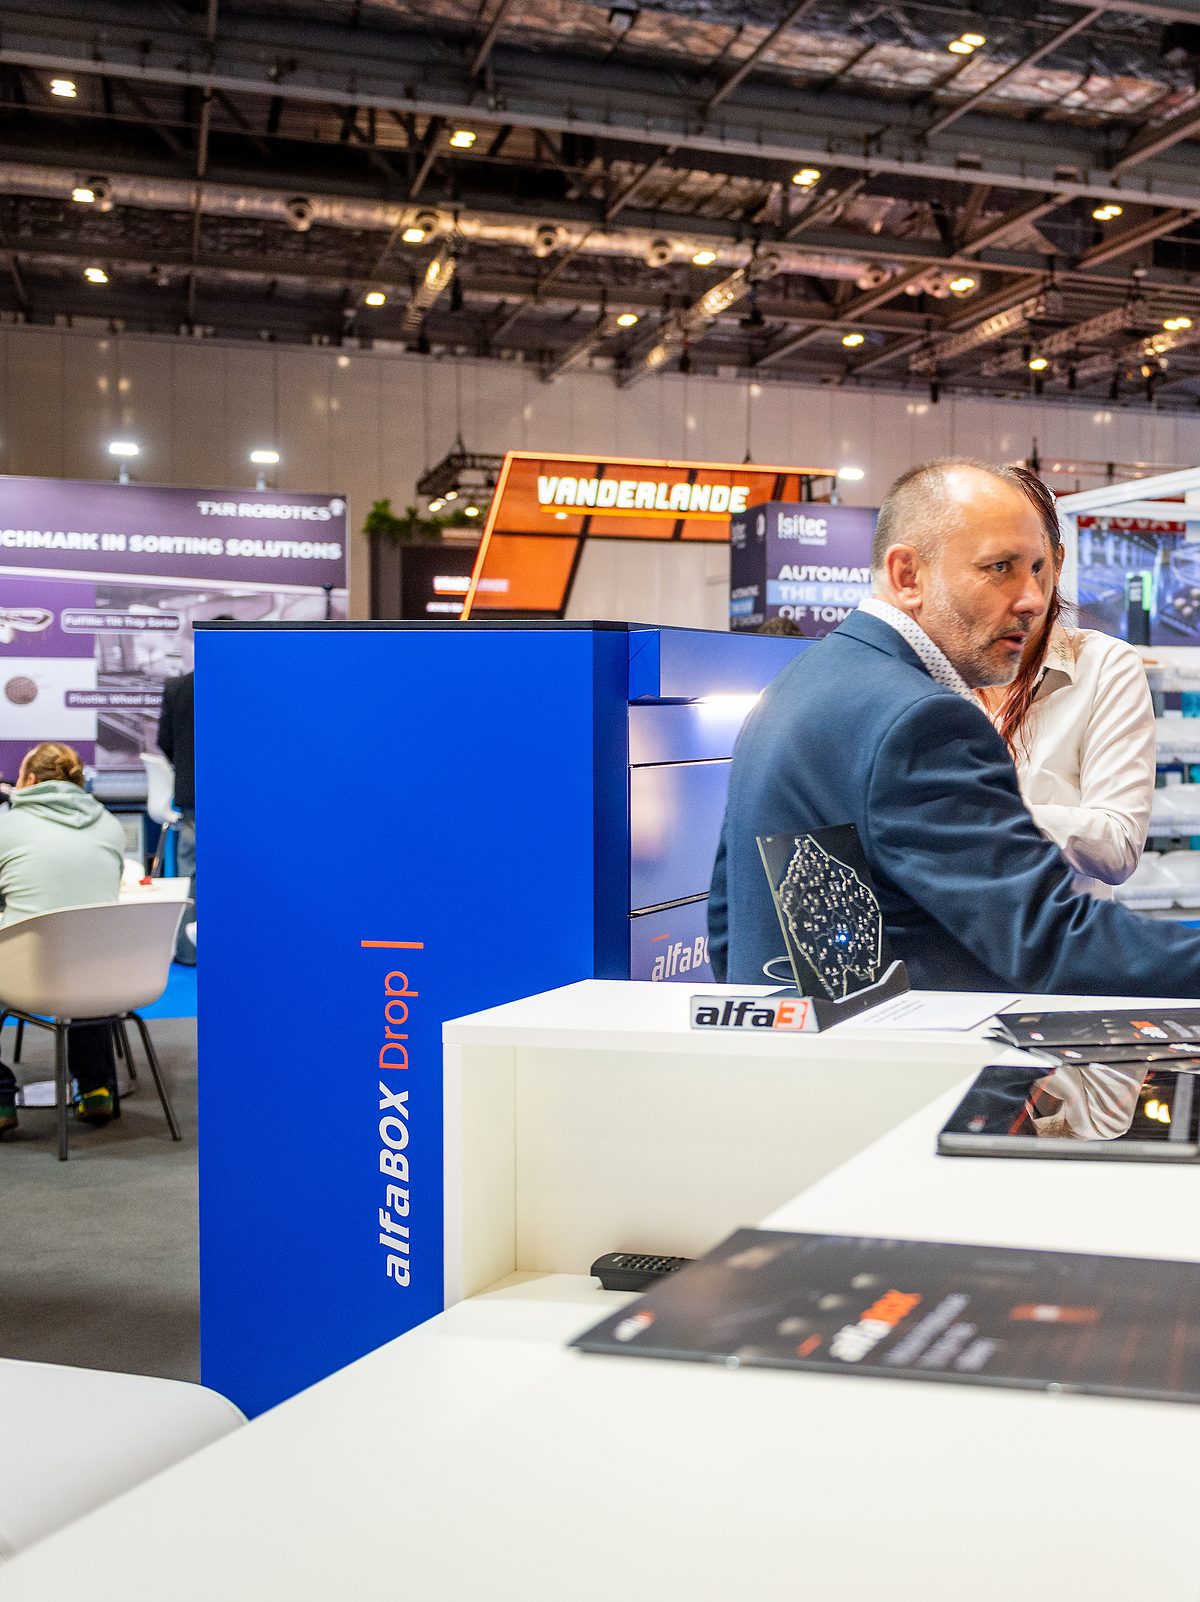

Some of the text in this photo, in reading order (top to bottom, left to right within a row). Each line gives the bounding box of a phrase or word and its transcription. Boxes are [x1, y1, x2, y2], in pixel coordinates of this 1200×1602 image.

[537, 476, 750, 513] VANDERLANDE
[197, 501, 331, 521] TXR ROBOTICS
[778, 512, 828, 539] Isitec
[0, 529, 342, 560] CHMARK IN SORTING SOLUTIONS
[779, 585, 817, 602] THE
[778, 605, 807, 620] OF
[695, 1001, 807, 1030] alfa3
[378, 970, 419, 1288] alfaBOX Drop
